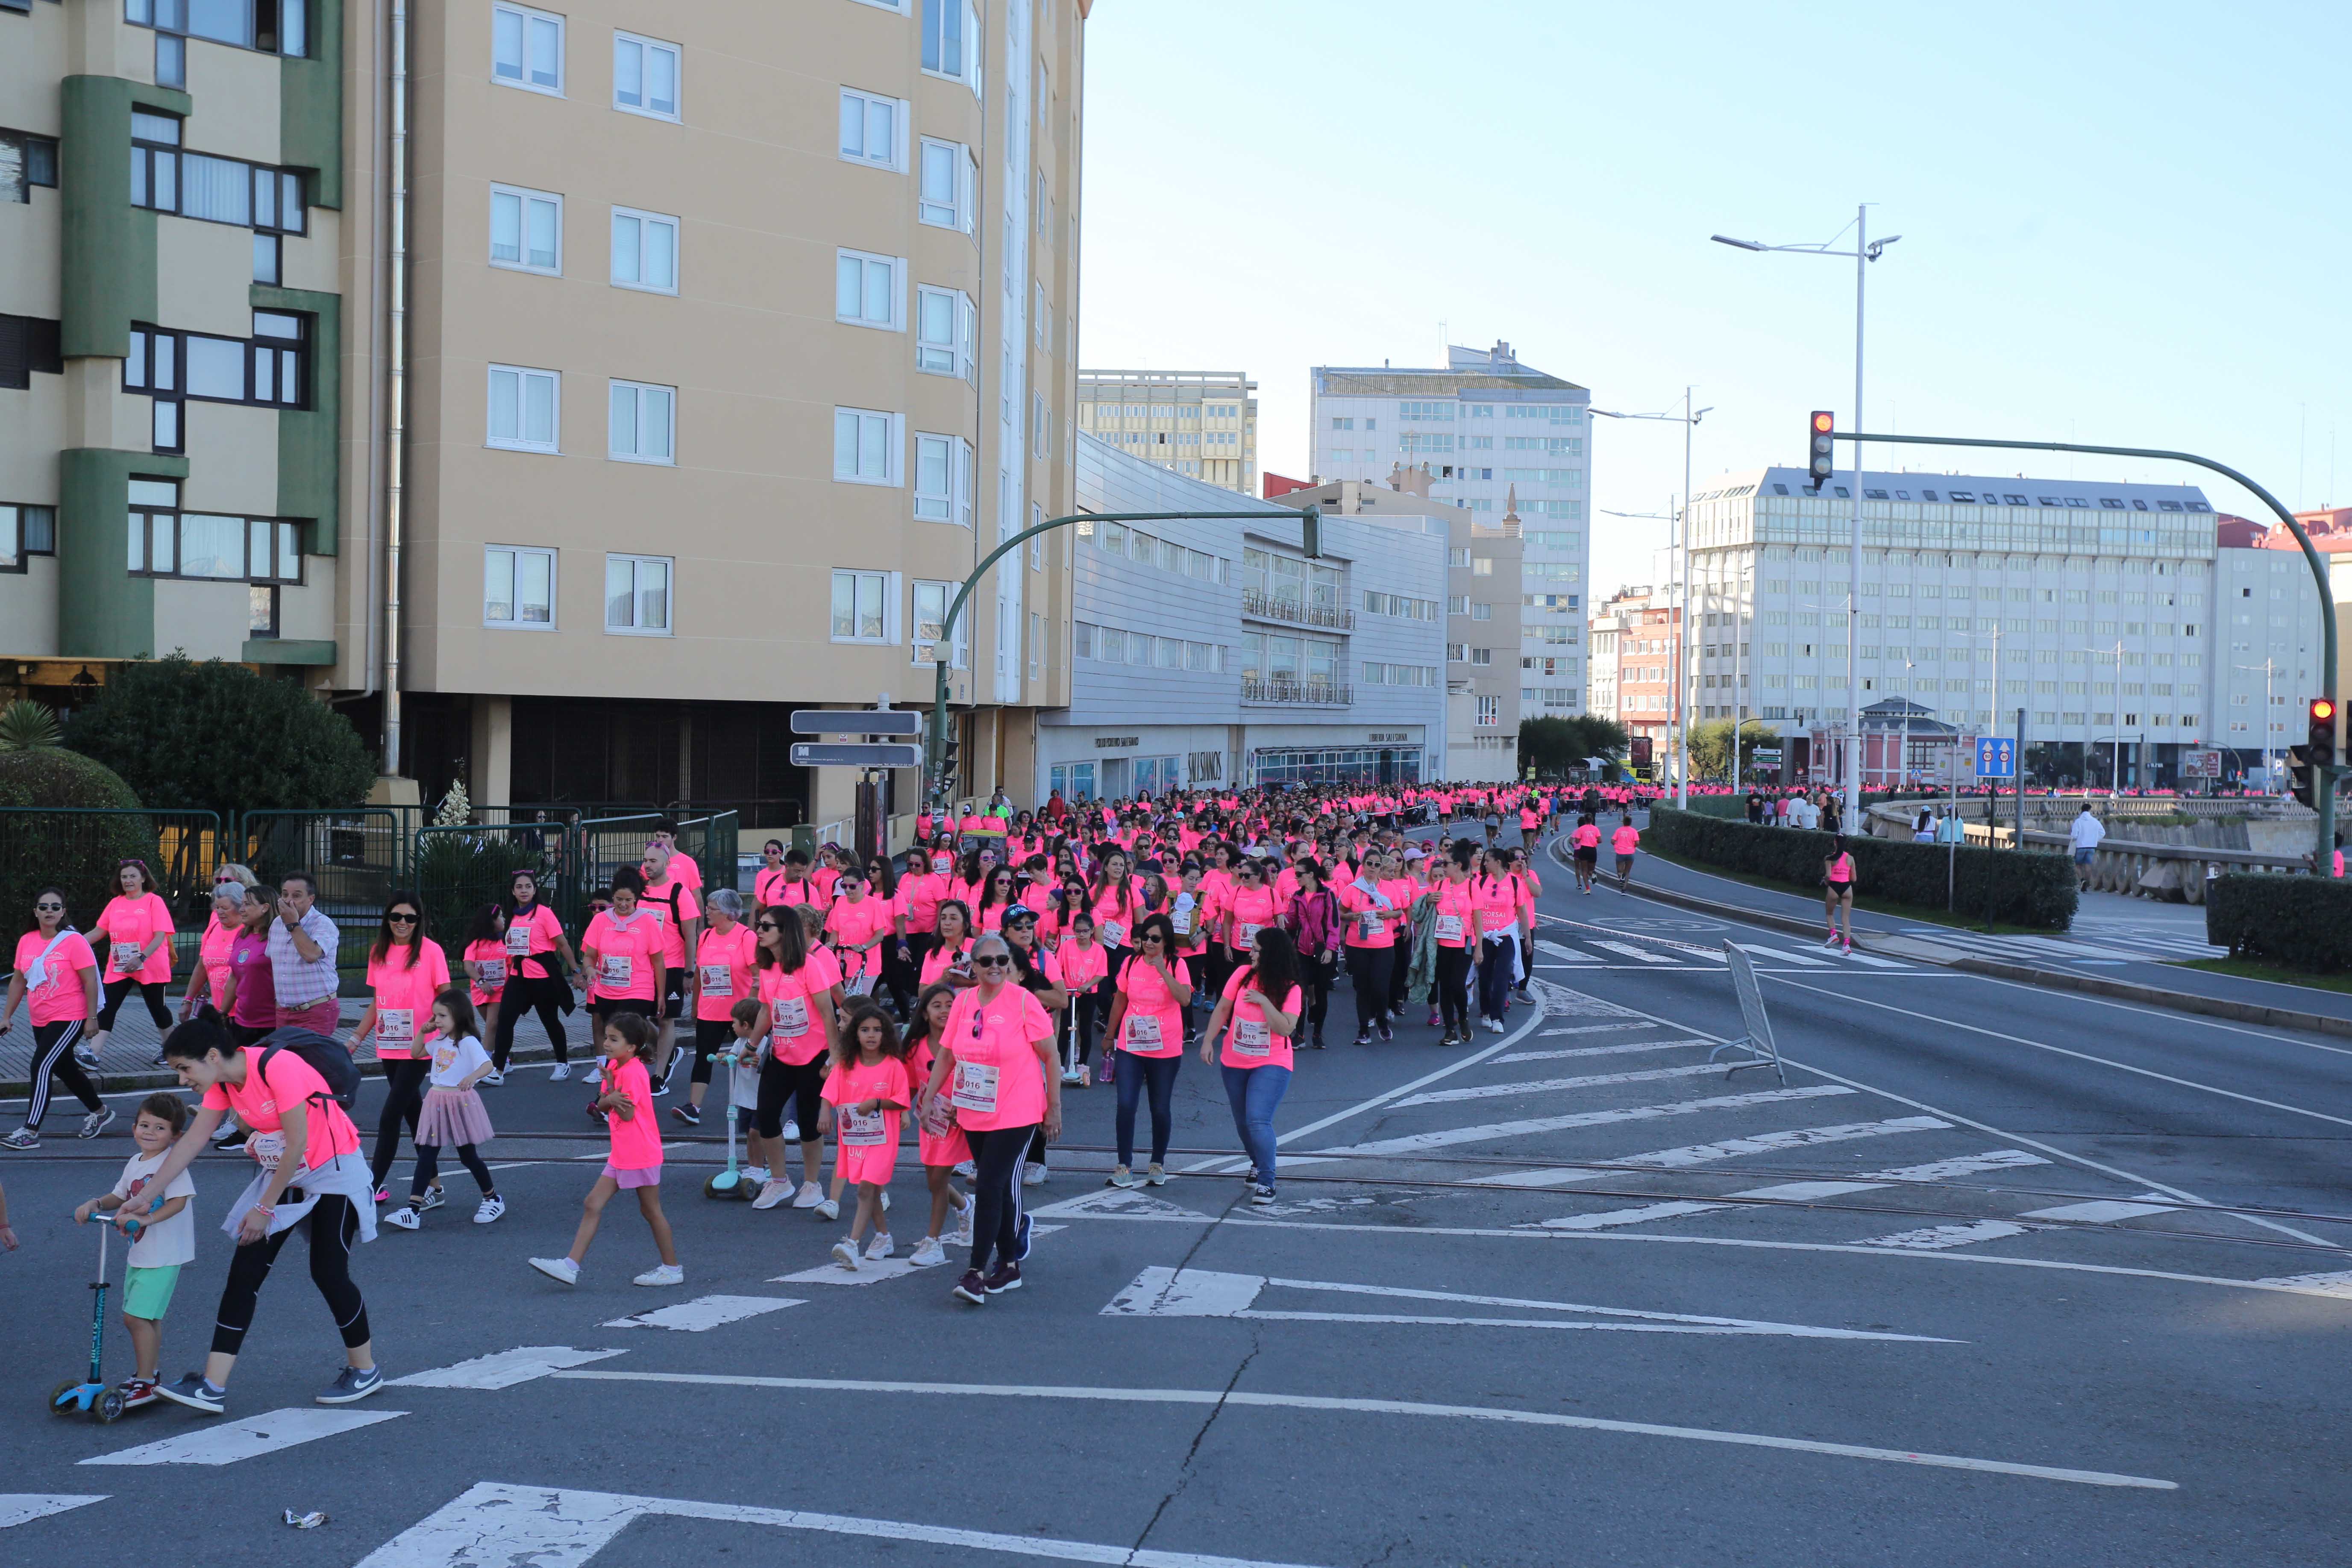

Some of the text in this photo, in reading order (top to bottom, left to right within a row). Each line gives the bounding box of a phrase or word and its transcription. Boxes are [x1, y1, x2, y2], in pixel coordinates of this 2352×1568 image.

[774, 1037, 793, 1045] UMA
[966, 1081, 980, 1089] 016
[848, 1147, 868, 1160] UM
